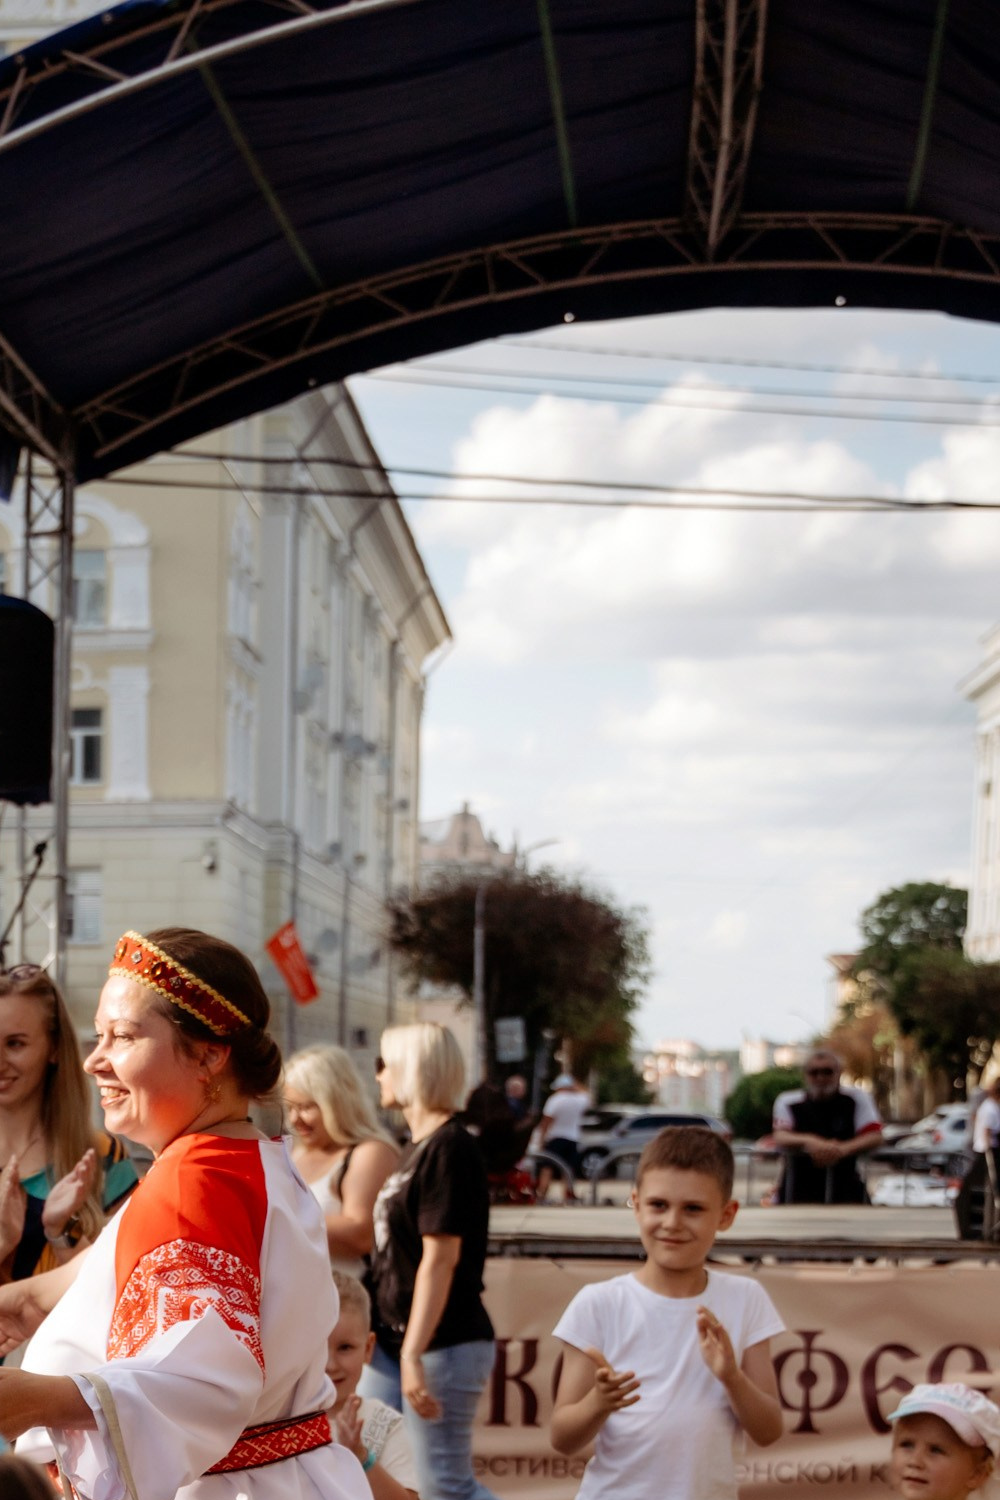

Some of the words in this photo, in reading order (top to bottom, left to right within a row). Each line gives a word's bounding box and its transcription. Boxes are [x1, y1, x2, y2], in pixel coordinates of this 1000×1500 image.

[484, 1338, 564, 1427] К
[472, 1454, 588, 1479] естива
[733, 1456, 857, 1484] енской
